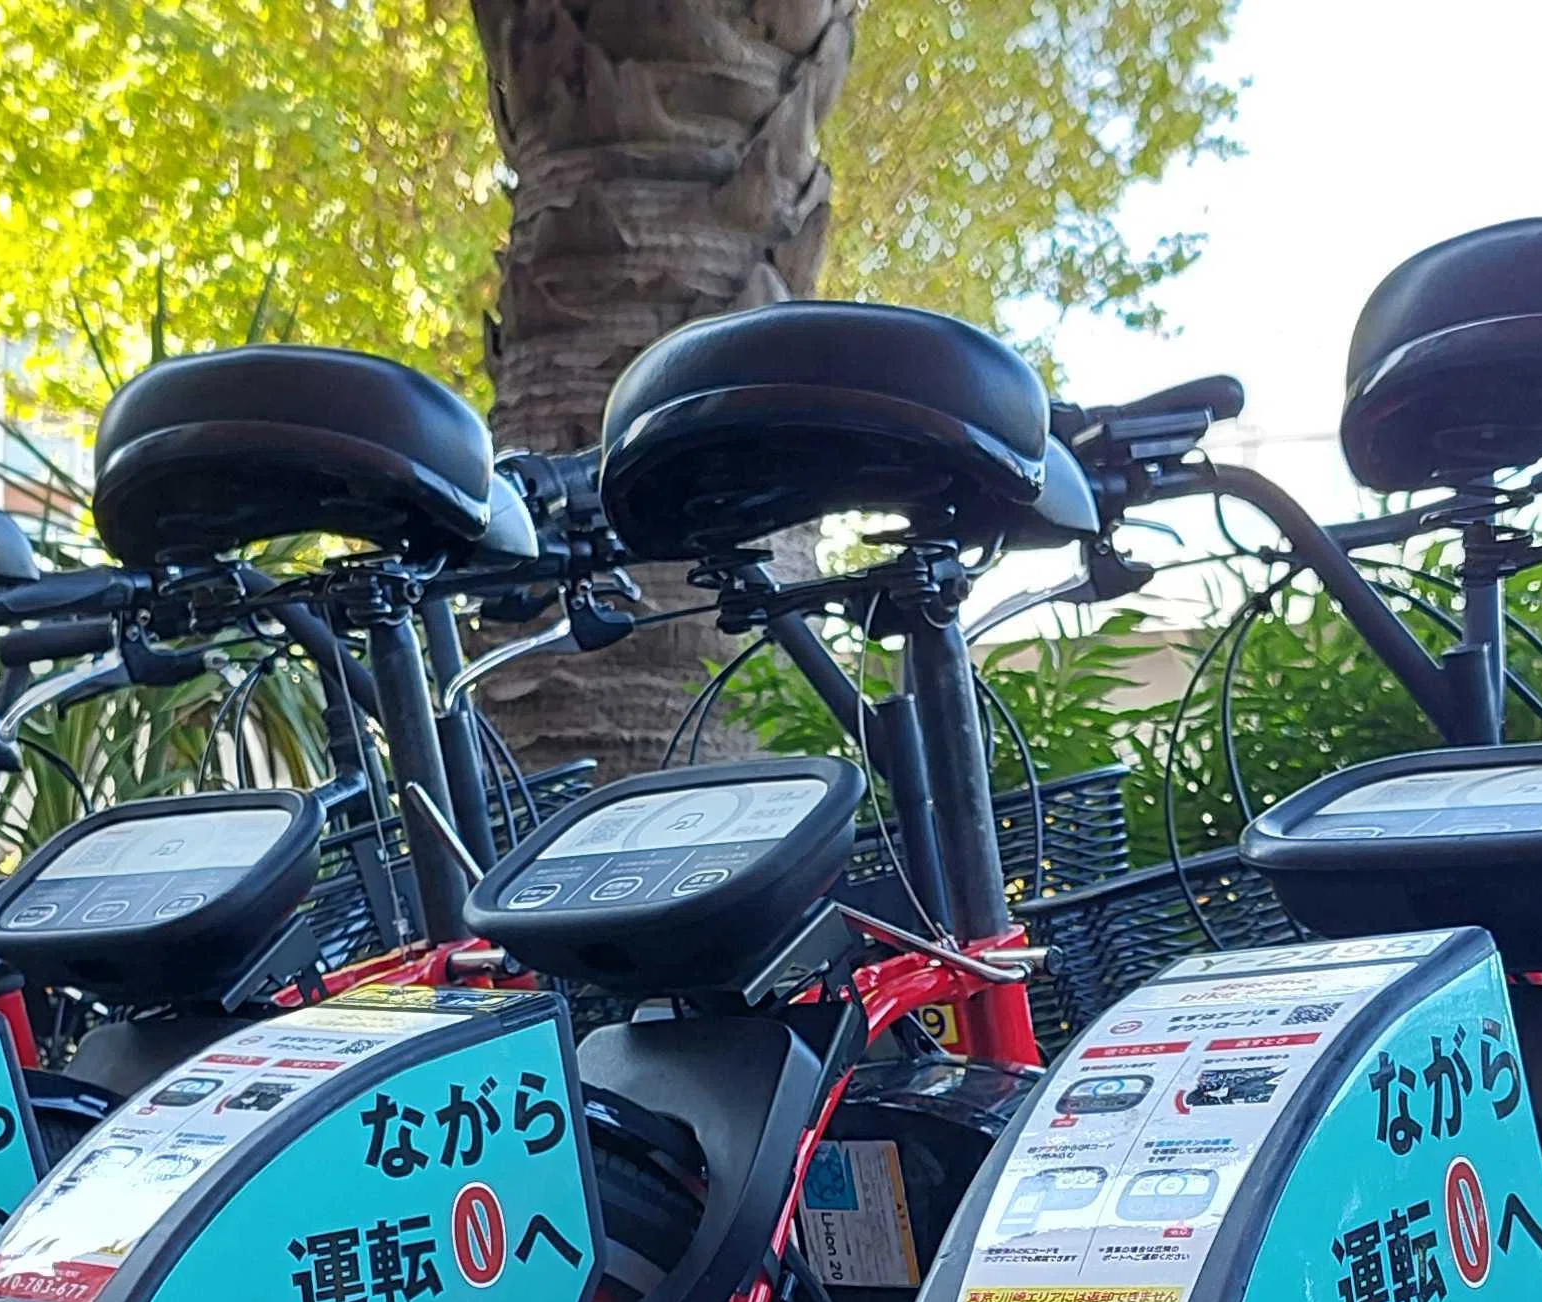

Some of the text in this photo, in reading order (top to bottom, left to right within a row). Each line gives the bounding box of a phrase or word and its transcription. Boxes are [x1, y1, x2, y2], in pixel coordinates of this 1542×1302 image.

[920, 1008, 946, 1039] 9
[360, 1071, 568, 1180] ながら
[1369, 1020, 1521, 1157] ながら
